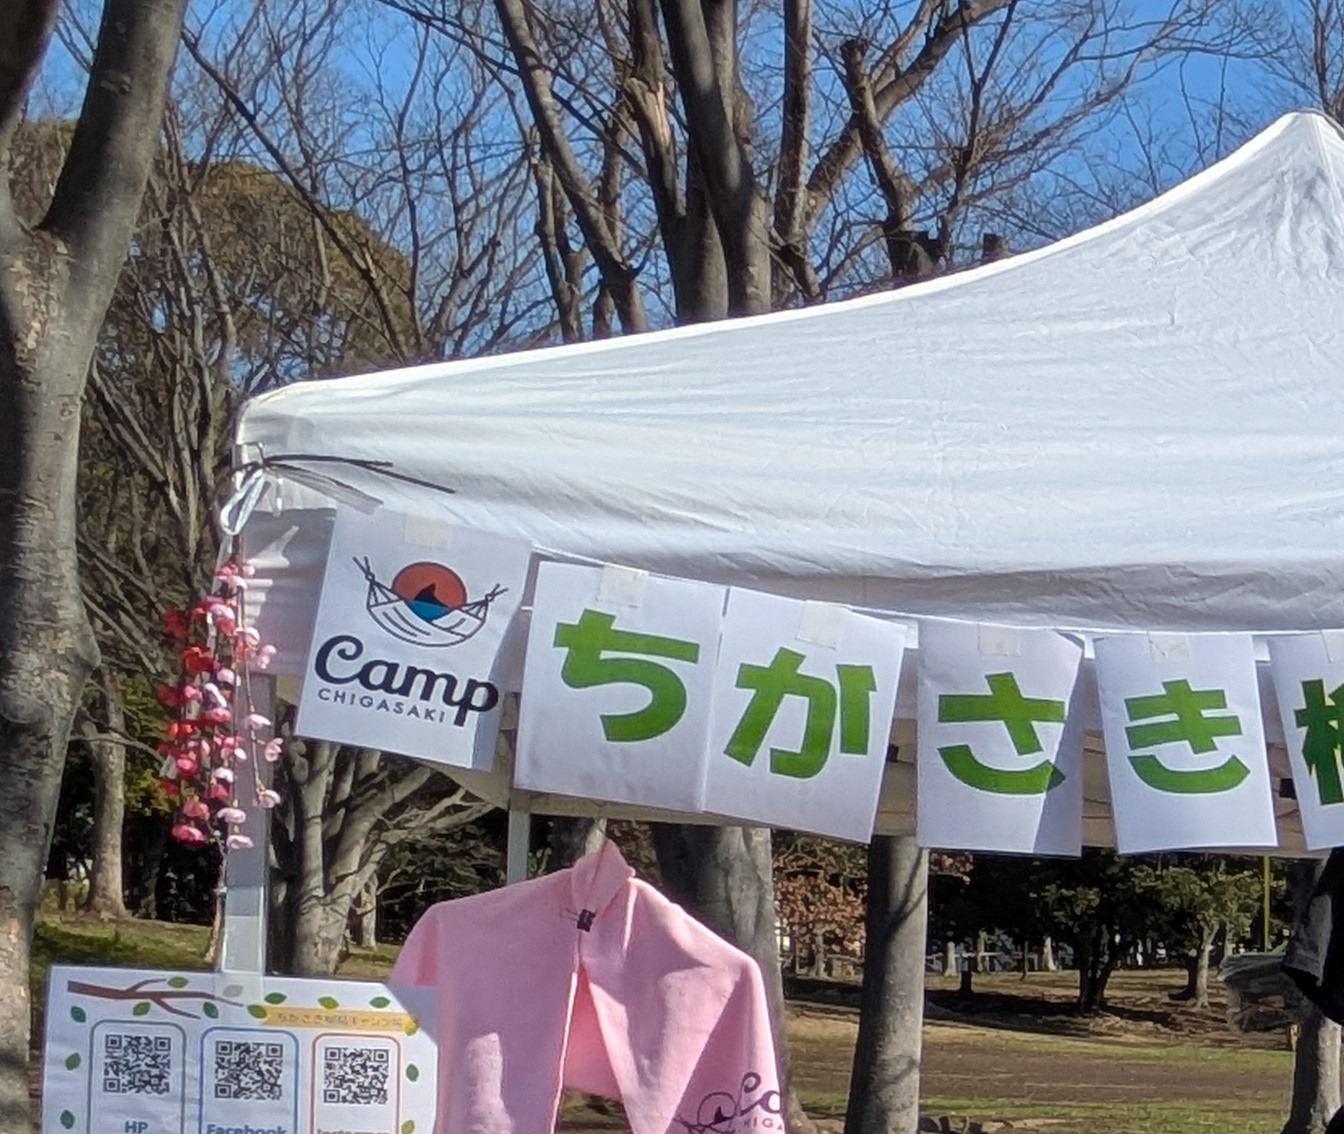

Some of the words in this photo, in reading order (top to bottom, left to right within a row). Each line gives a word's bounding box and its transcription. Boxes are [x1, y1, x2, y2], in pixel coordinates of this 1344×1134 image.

[315, 635, 499, 727] Camp
[318, 687, 446, 723] CHIGASAKI
[124, 1121, 149, 1134] HP
